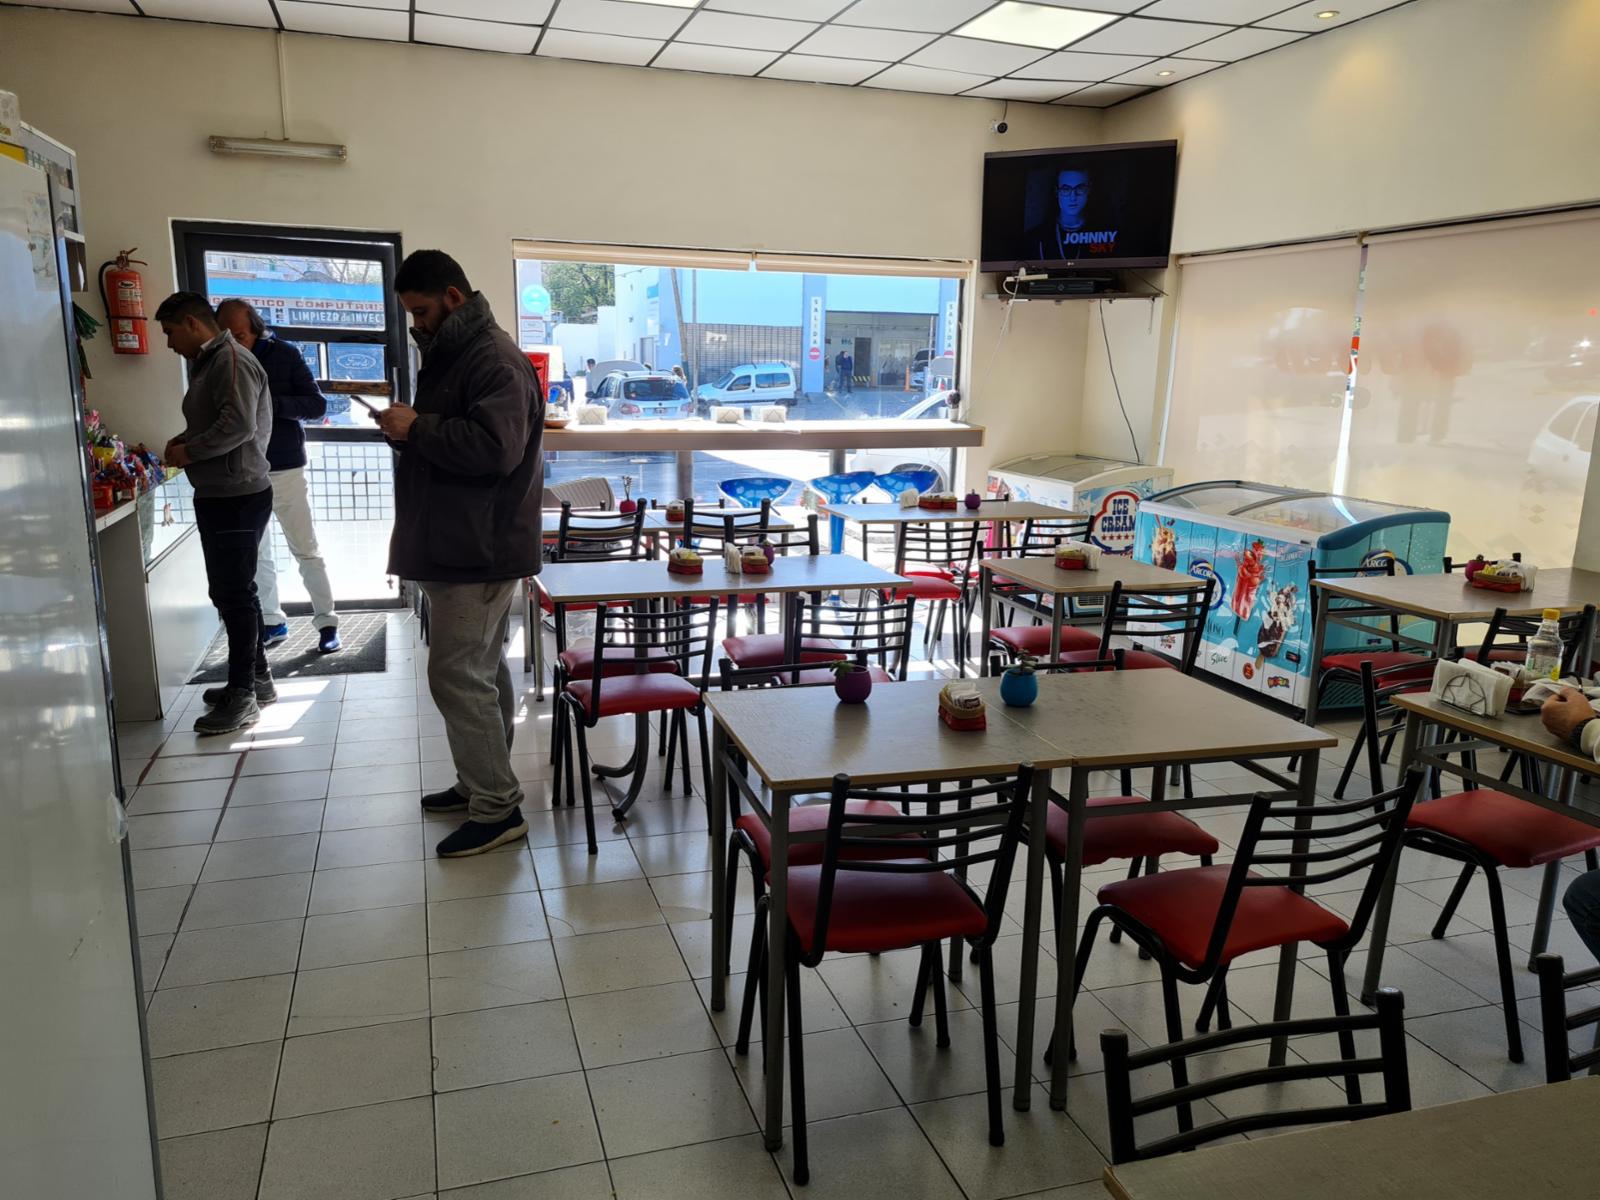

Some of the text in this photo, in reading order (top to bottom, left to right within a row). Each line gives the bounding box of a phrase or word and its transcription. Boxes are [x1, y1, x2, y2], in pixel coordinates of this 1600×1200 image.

[1063, 231, 1118, 244] JOHNNY
[1089, 243, 1116, 253] SKY
[292, 311, 340, 322] LIMPIEZA
[1112, 498, 1129, 515] ICE
[1190, 565, 1212, 577] ARCOR
